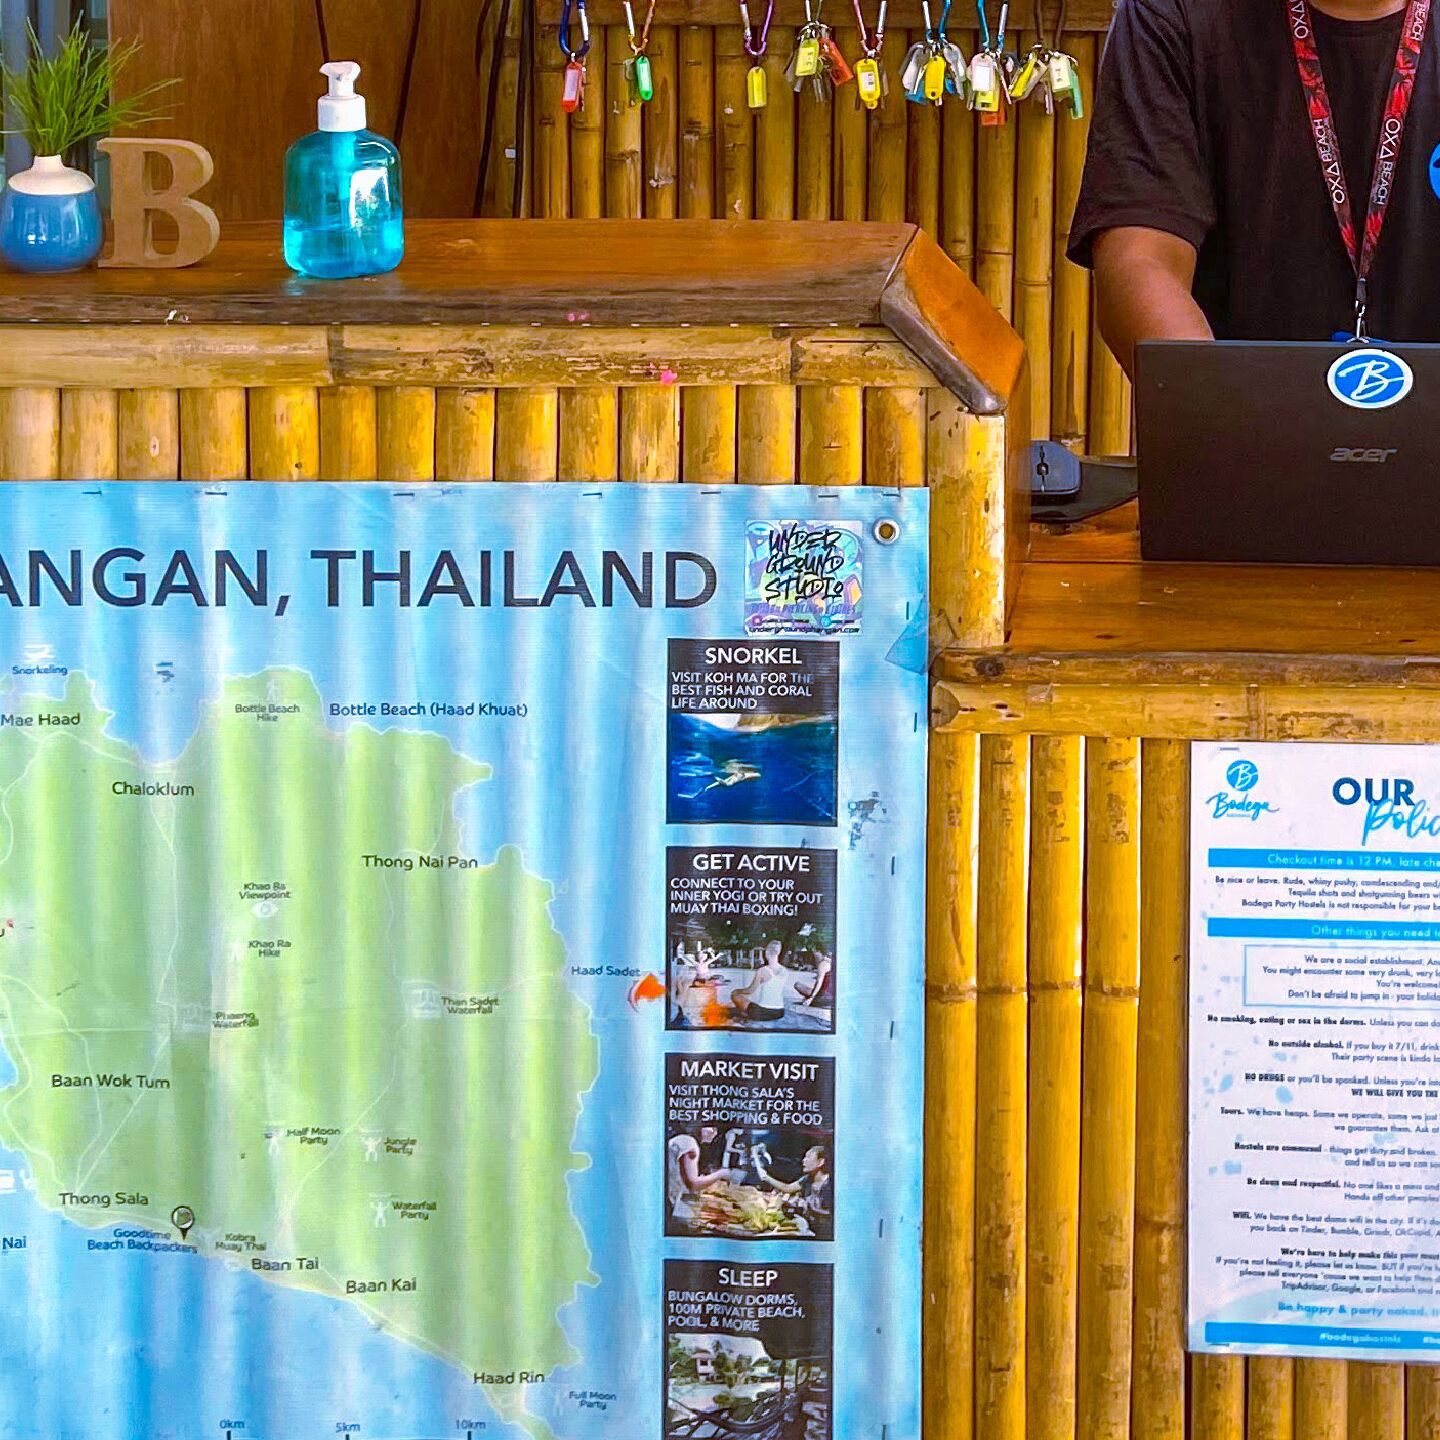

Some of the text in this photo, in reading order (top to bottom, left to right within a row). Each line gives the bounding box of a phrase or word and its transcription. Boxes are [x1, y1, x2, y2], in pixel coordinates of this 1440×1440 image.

[1313, 118, 1331, 162] BEACH
[1375, 159, 1393, 205] BEACH
[97, 137, 220, 268] B
[1330, 444, 1397, 463] acer
[311, 549, 717, 607] THAILAND
[705, 647, 803, 664] SNORKEL
[672, 671, 701, 683] VISIT
[705, 672, 733, 684] KOH
[736, 672, 758, 683] MA
[761, 672, 787, 684] FOR
[672, 684, 812, 697] BEST FISH AND CORAL
[329, 702, 529, 719] Bottle Beach (Haad Khuat)
[672, 697, 758, 709] LIFE AROUND
[1, 712, 81, 727] Mae Haad
[111, 780, 196, 797] Chaloklum
[1332, 776, 1415, 807] OUR
[1206, 791, 1281, 821] Bodega
[362, 854, 478, 872] Thong Nai Pan
[693, 853, 811, 872] GET ACTIVE
[1267, 854, 1318, 866] Checkout
[1320, 856, 1343, 866] time
[1359, 856, 1371, 866] 12
[670, 877, 795, 890] CONNECT TO YOUR
[681, 1060, 819, 1082] MARKET VISIT
[51, 1074, 171, 1090] Baan Wok Tum
[669, 1084, 795, 1099] VISIT THONG SALA'S
[59, 1191, 149, 1208] Thong Sala
[251, 1256, 320, 1272] Baan Tai
[718, 1267, 779, 1287] SLEEP
[345, 1278, 418, 1295] Baan Kai
[669, 1303, 806, 1320] 100M PRIVATE BEACH,
[473, 1371, 546, 1385] Haad Rin
